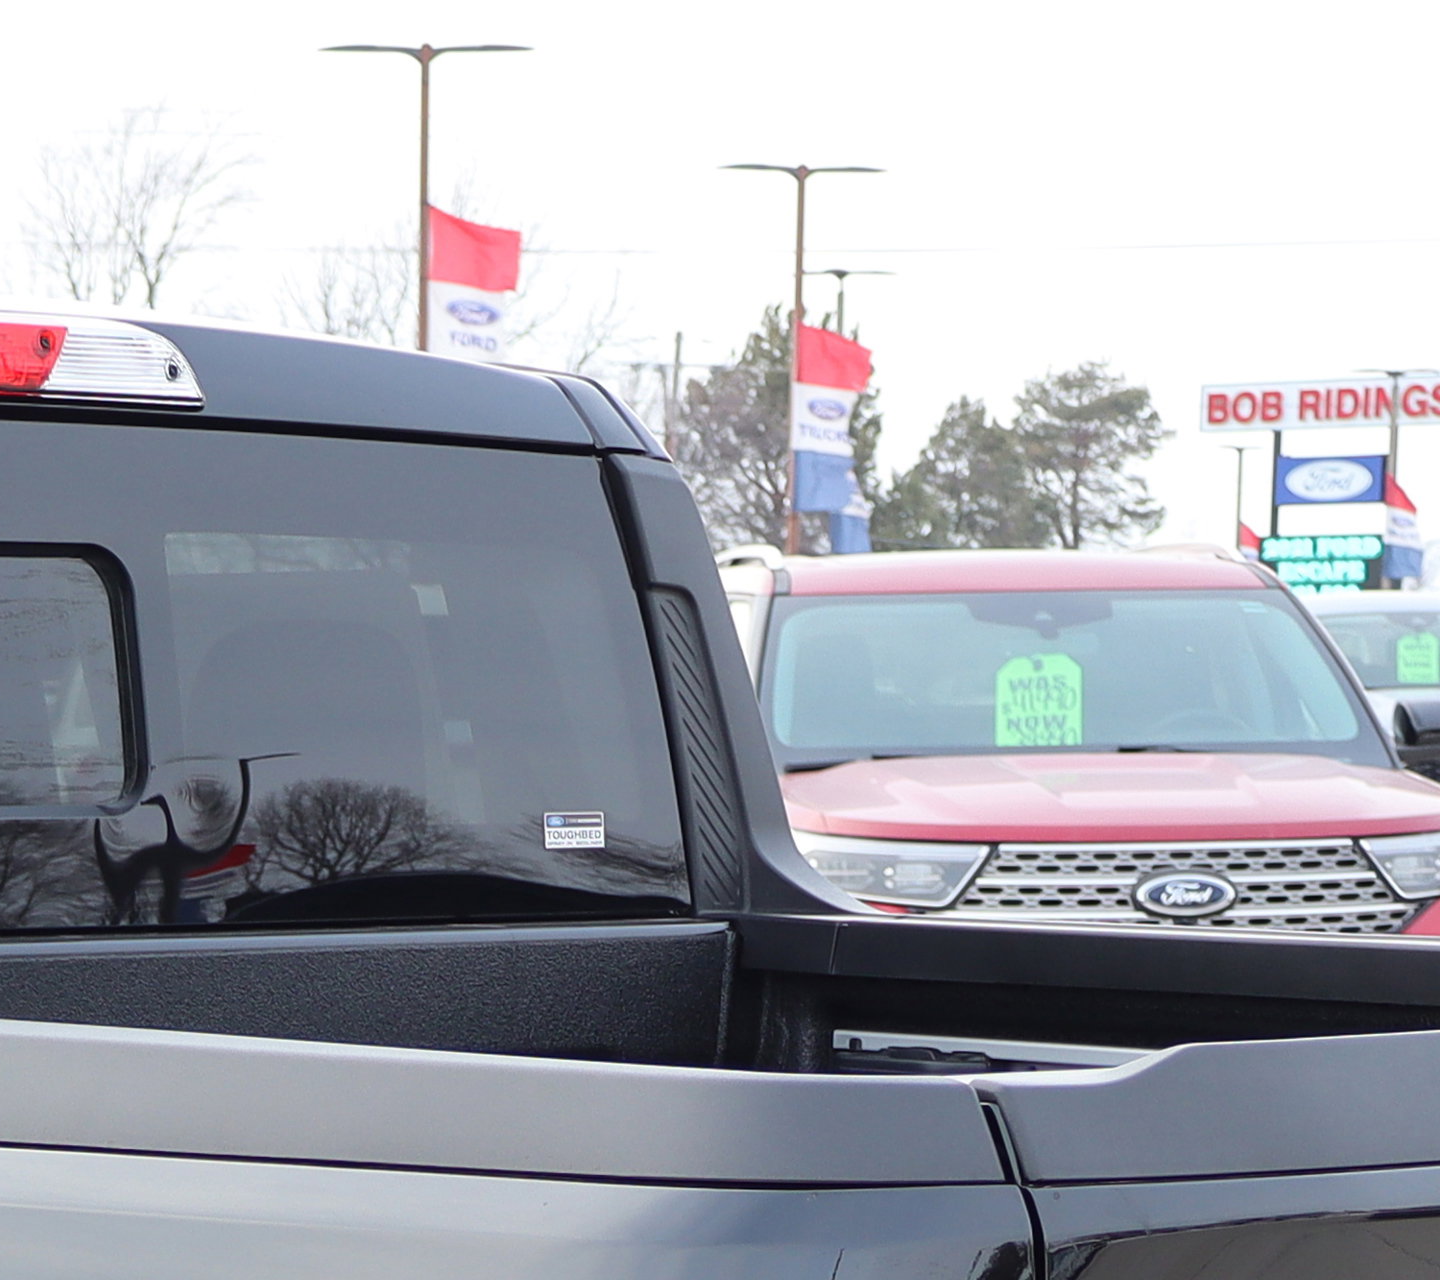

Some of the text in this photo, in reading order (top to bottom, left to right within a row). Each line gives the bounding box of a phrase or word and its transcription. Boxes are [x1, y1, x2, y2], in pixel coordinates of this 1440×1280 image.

[1207, 390, 1283, 424] BOB
[547, 829, 602, 840] TOUGHBED
[1160, 881, 1214, 906] Ford
